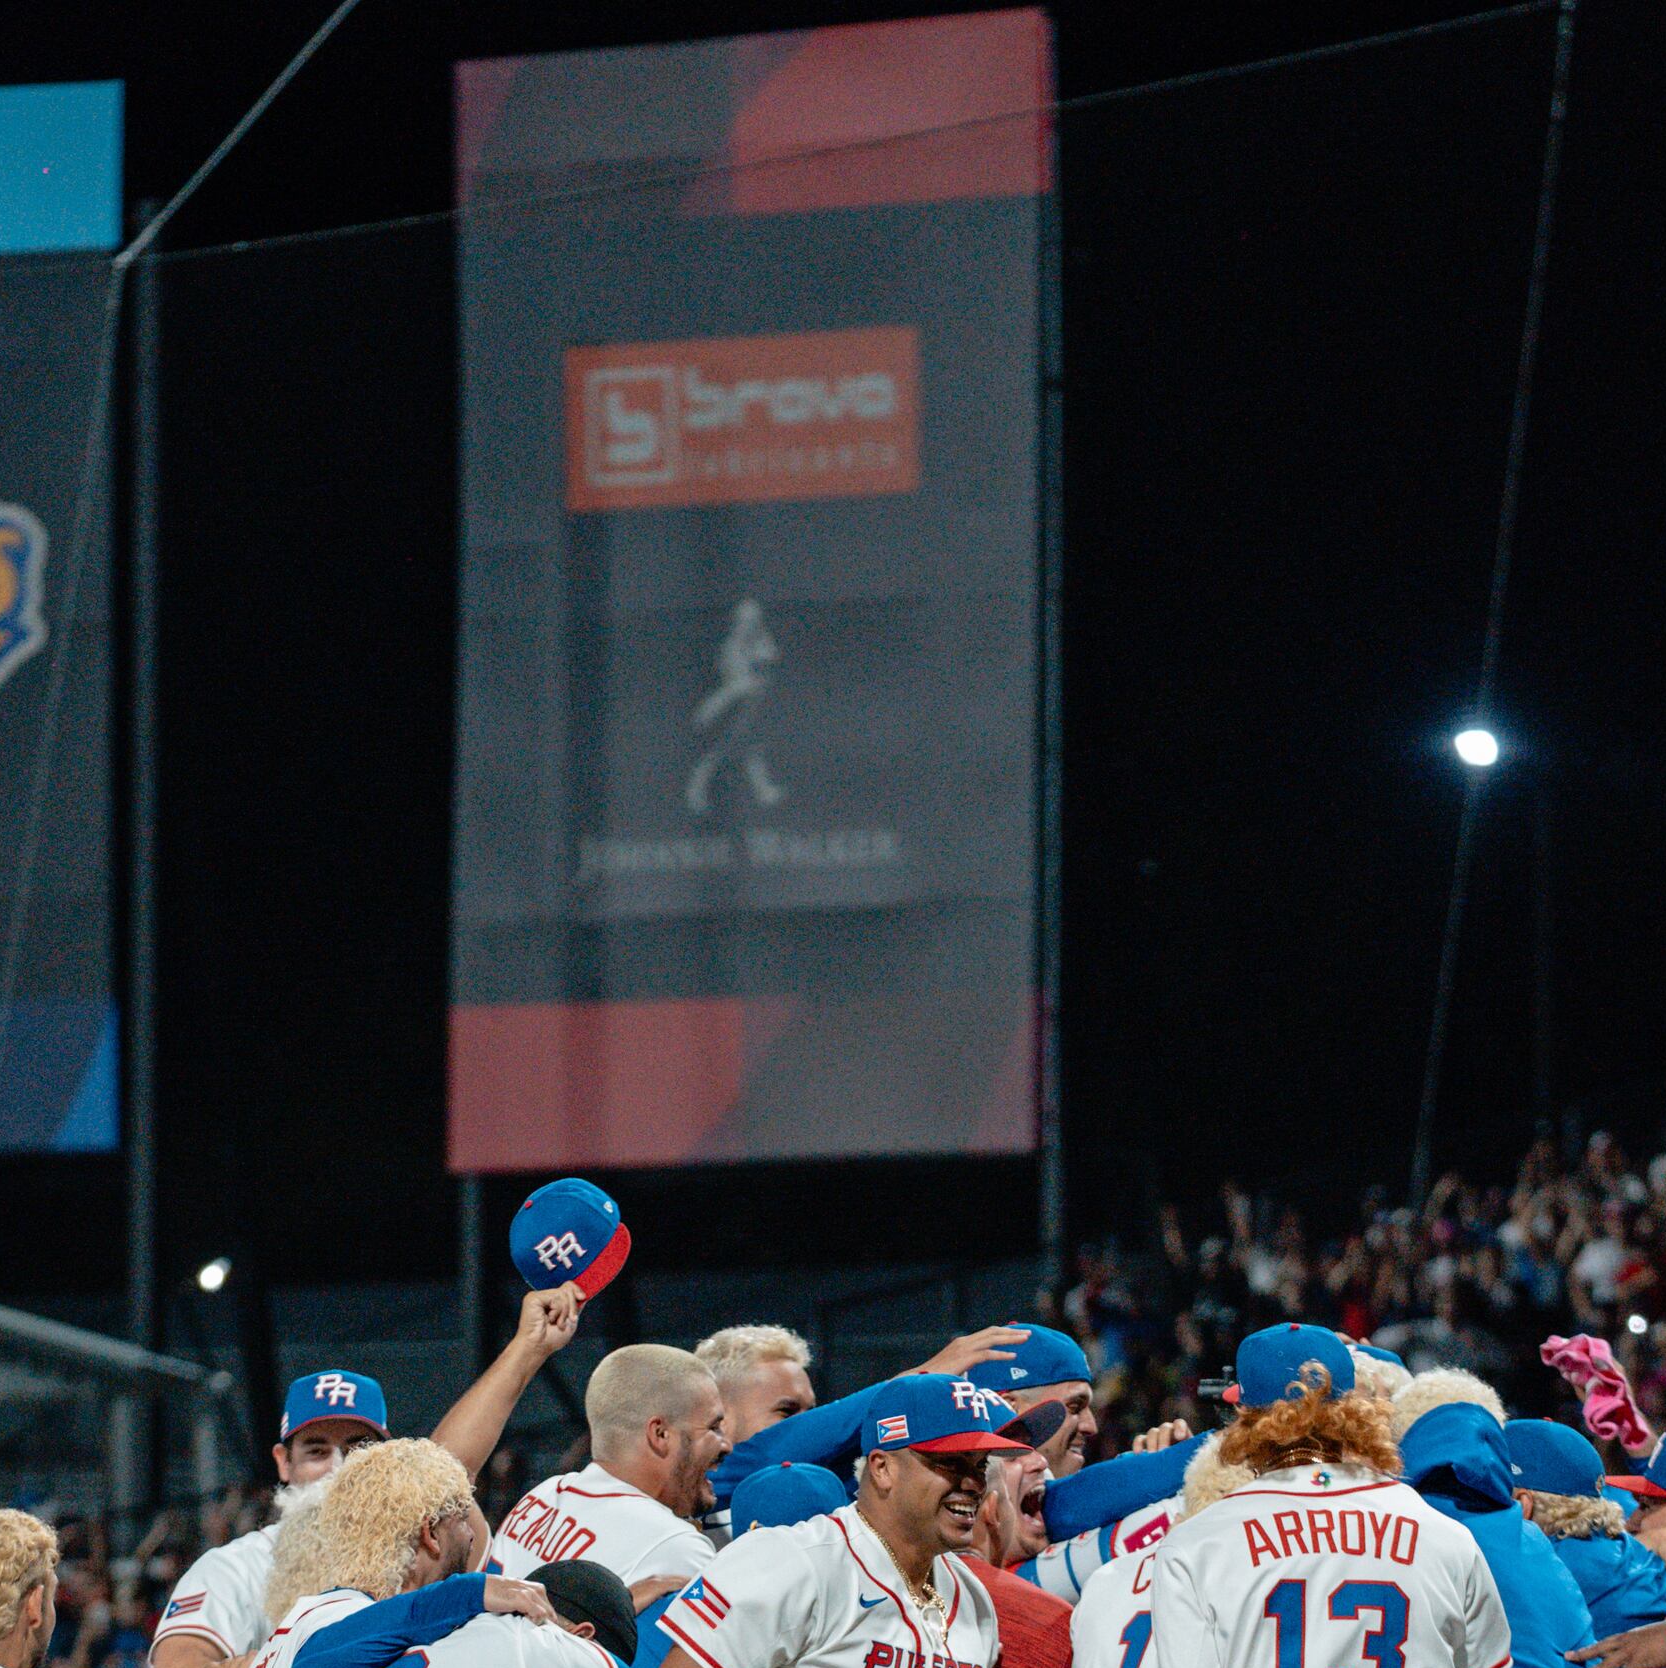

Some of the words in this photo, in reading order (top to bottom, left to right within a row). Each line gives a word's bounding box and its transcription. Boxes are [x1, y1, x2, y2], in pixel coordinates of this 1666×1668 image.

[534, 1230, 588, 1271] PR
[314, 1373, 357, 1408] PR
[949, 1381, 991, 1422] PR
[497, 1494, 597, 1564] RENADO
[1242, 1509, 1420, 1568] ARROYO
